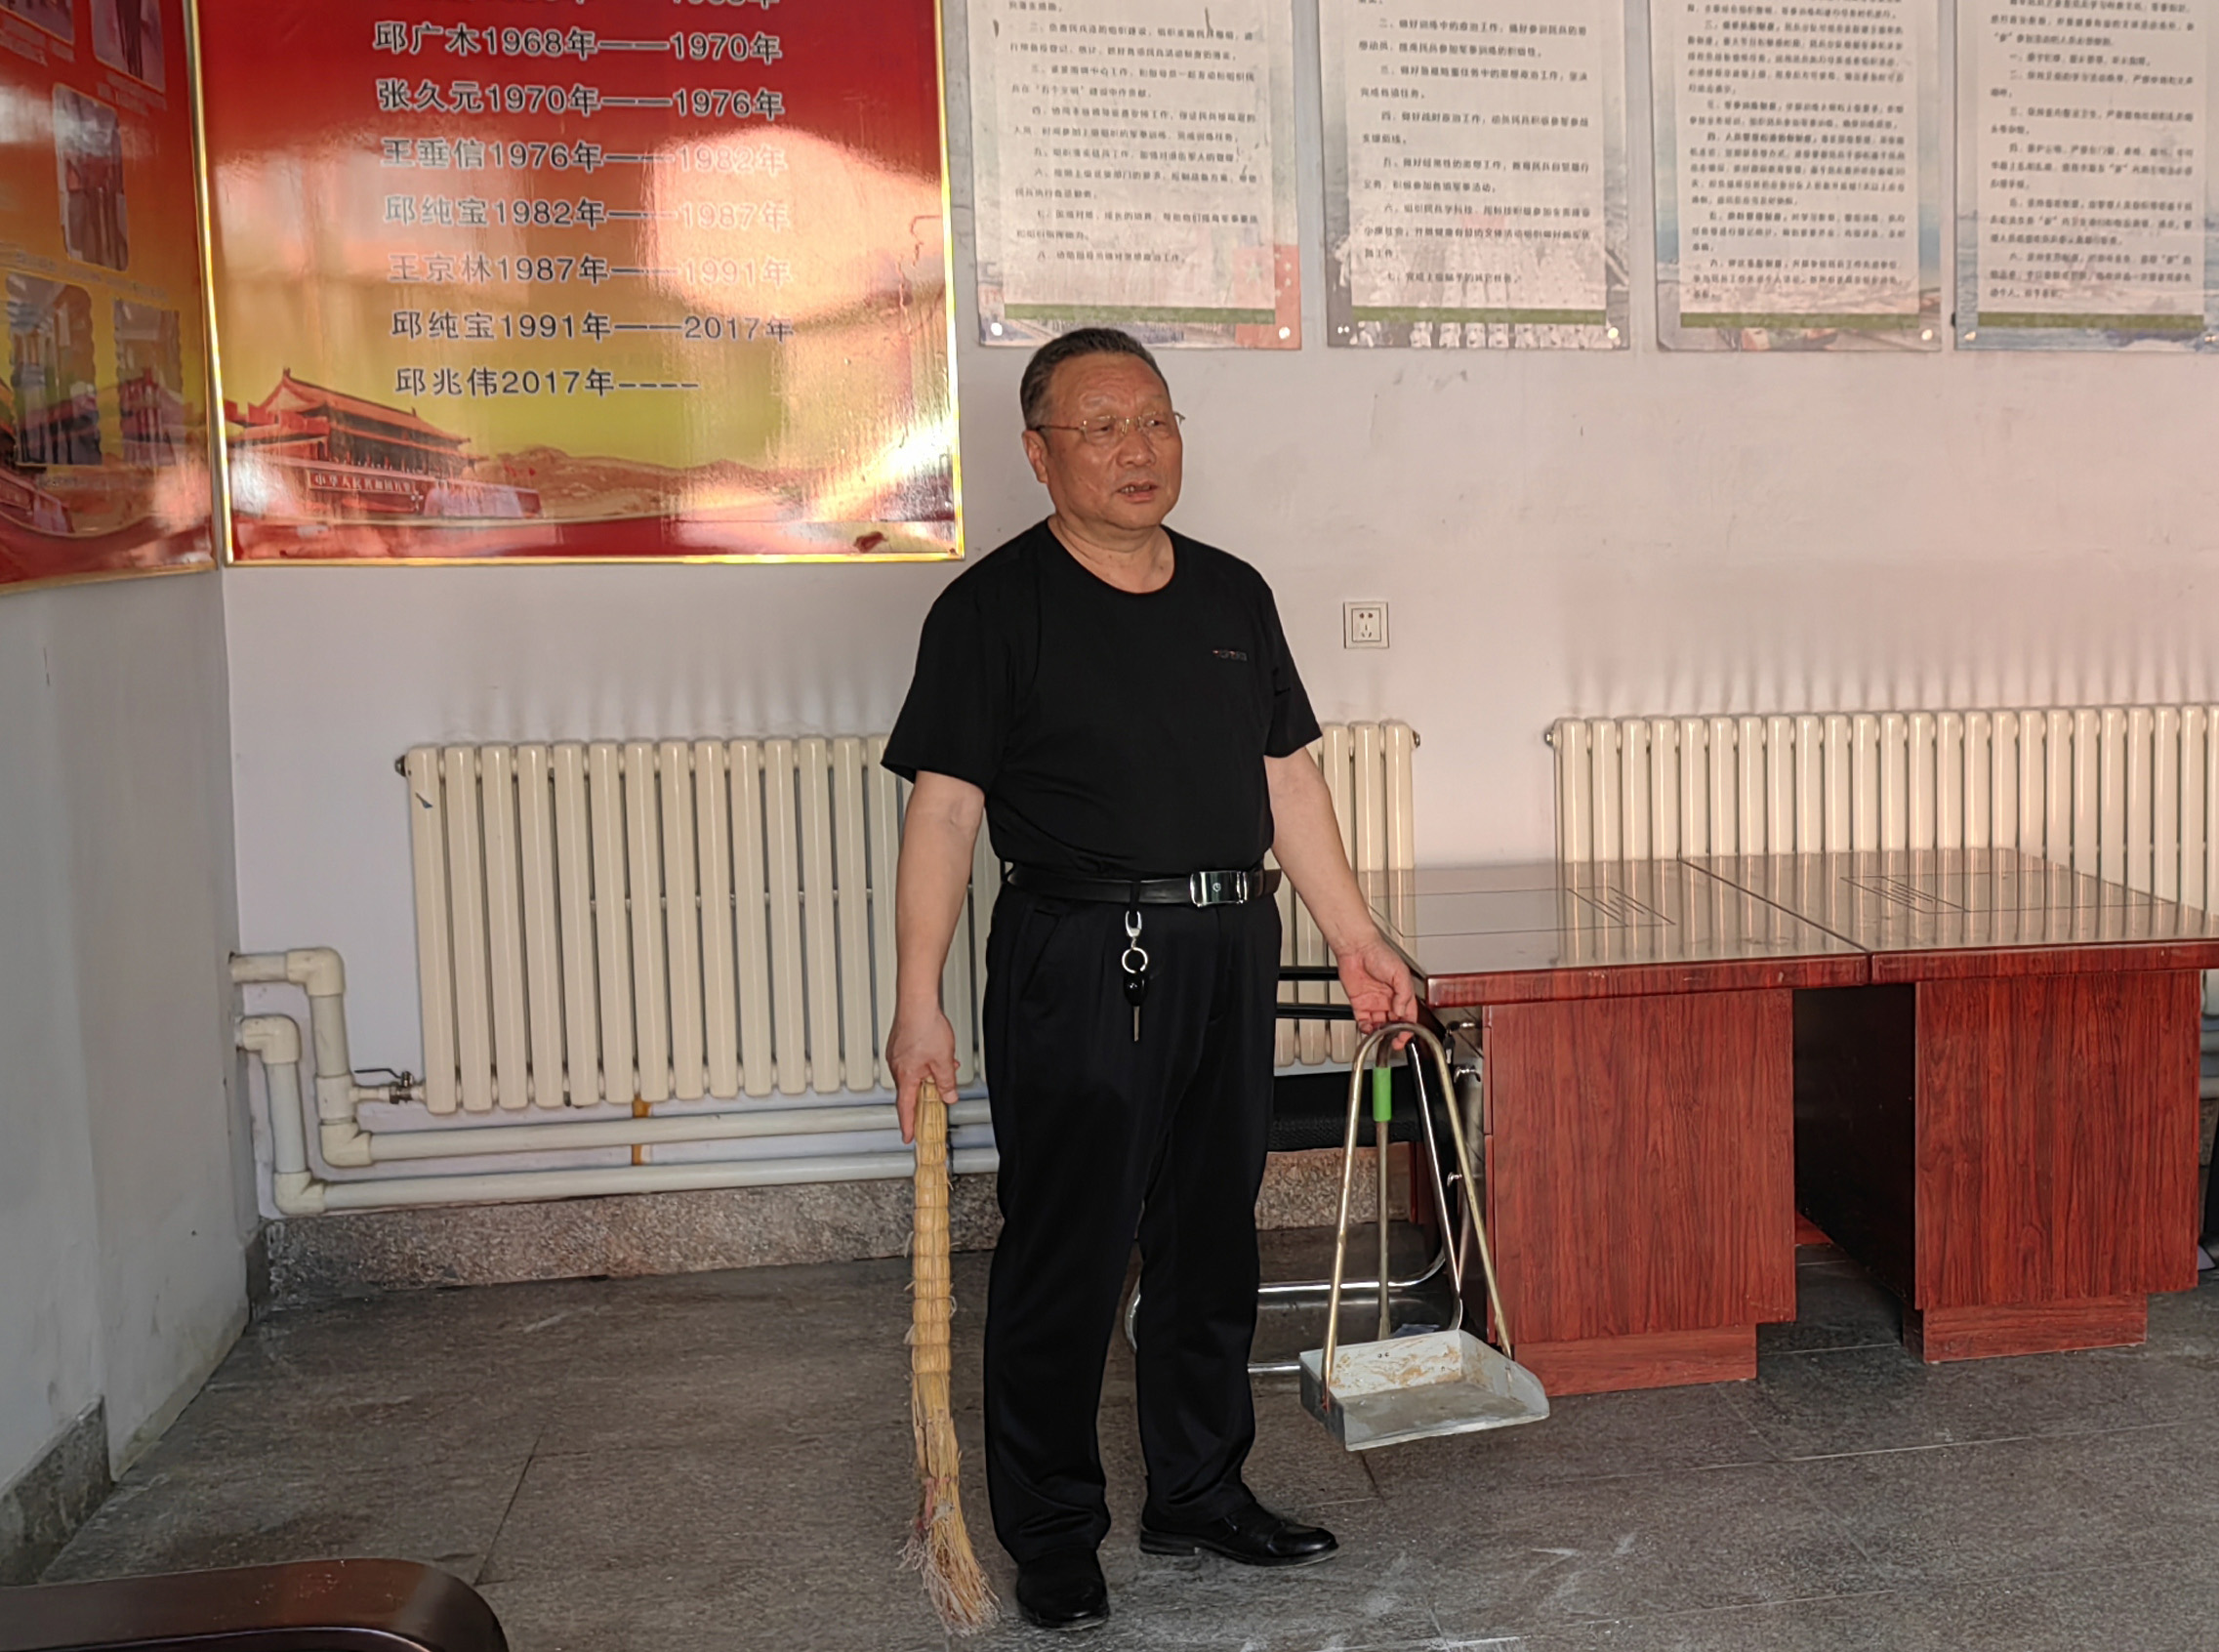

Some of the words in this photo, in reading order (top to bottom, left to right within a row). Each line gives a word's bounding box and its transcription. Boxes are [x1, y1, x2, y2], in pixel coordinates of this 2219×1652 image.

[373, 21, 783, 63] 邱广木1968年——1970年
[377, 79, 785, 119] 张久元1970年——1976年
[391, 310, 794, 343] 邱纯宝1991年——2017年
